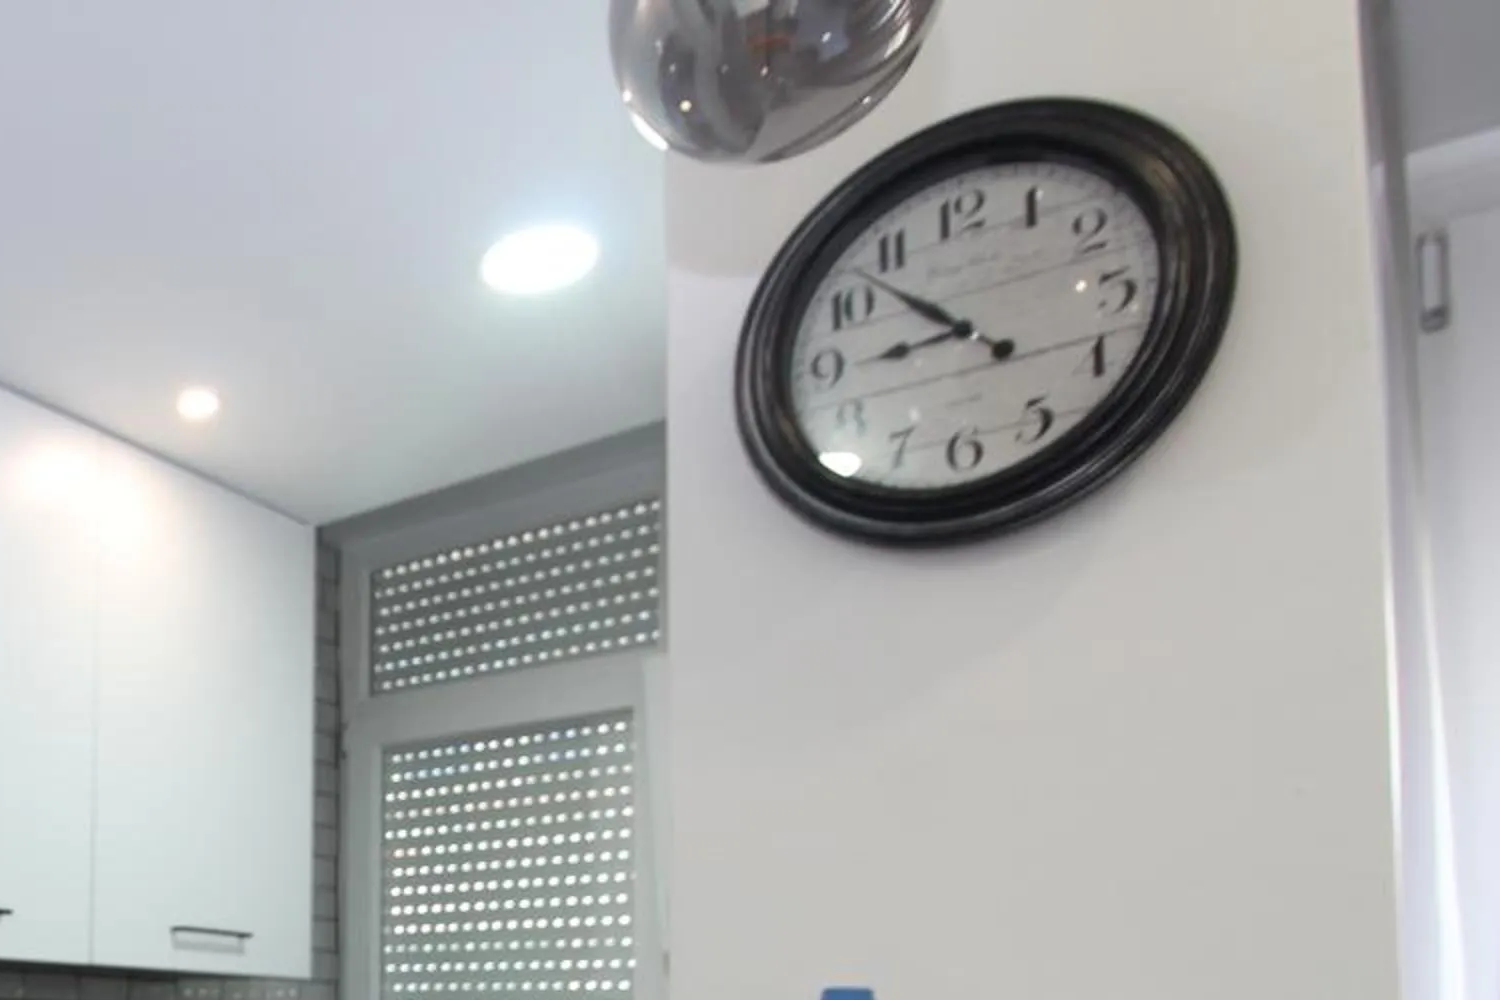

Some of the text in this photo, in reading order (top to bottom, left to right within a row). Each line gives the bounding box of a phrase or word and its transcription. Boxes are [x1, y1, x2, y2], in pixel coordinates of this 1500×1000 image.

[938, 189, 986, 241] 12
[1024, 186, 1041, 228] 1
[878, 228, 906, 273] 11
[1072, 208, 1108, 254] 2
[832, 285, 876, 331] 10
[1099, 266, 1138, 314] 3
[810, 349, 846, 388] 9
[1015, 395, 1054, 444] 5
[888, 425, 916, 469] 7
[946, 427, 984, 471] 6
